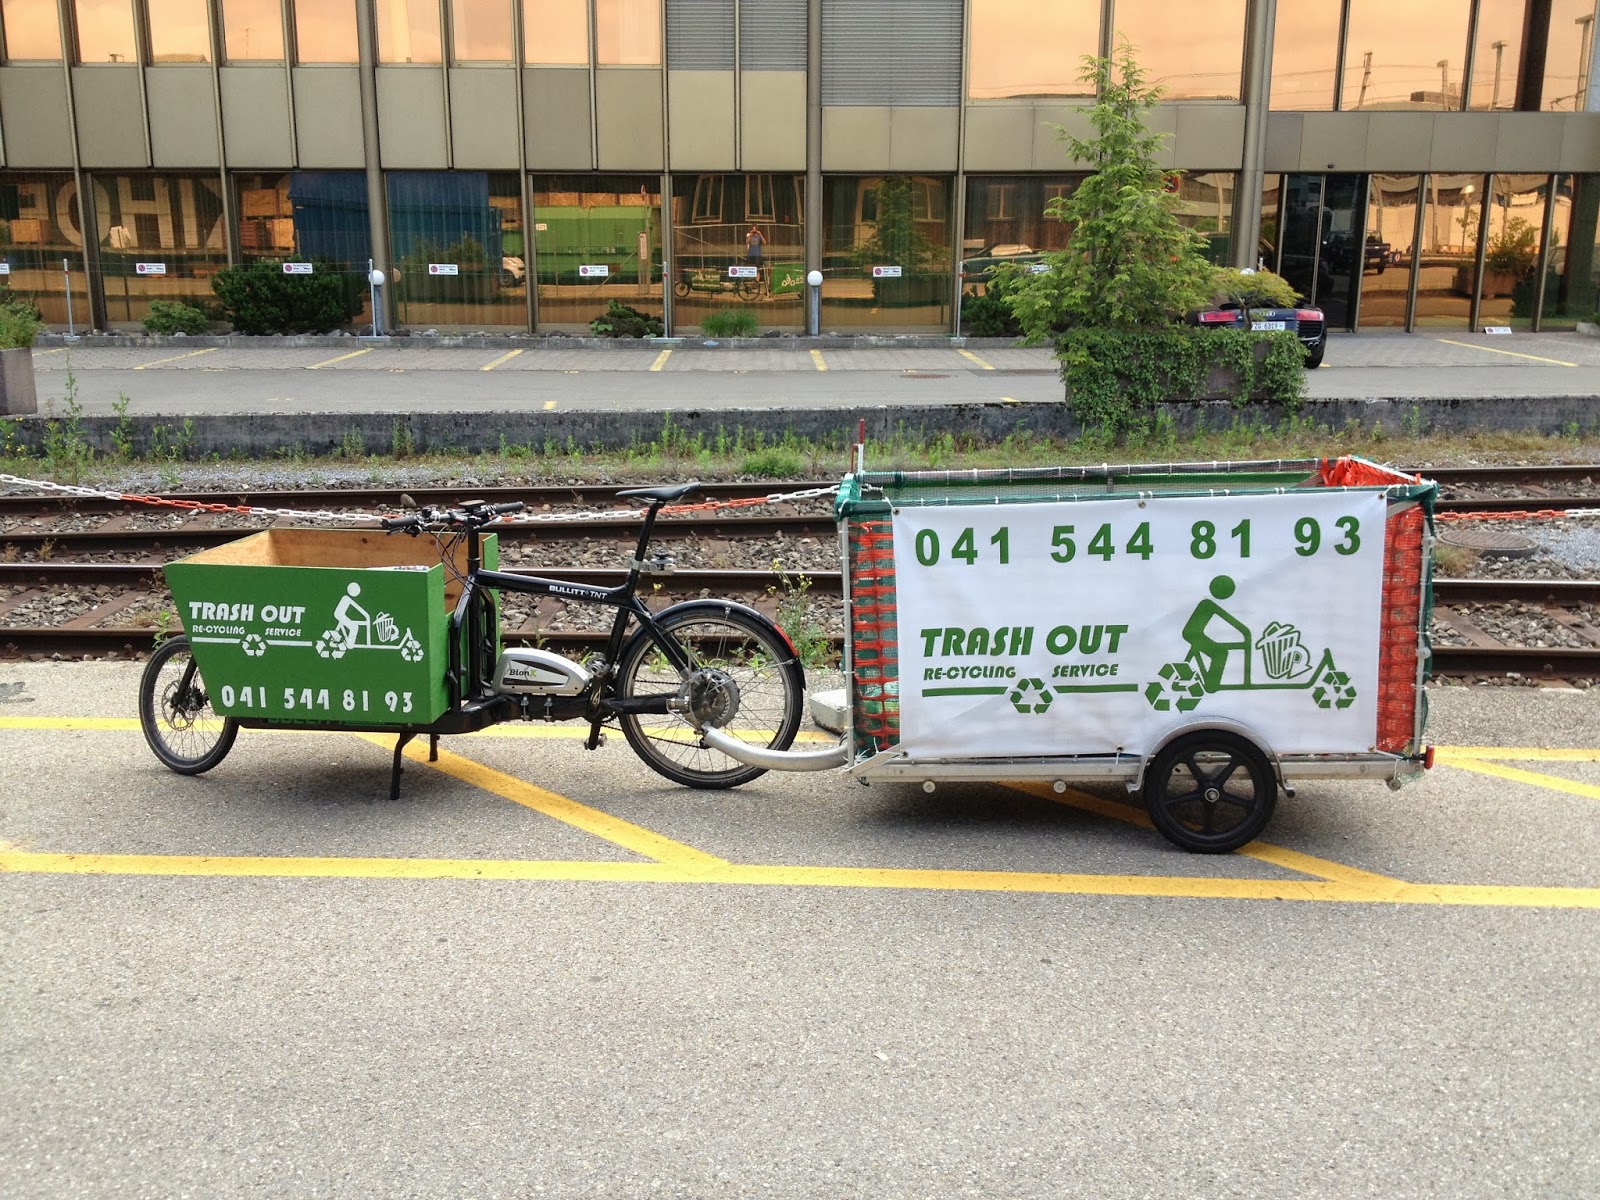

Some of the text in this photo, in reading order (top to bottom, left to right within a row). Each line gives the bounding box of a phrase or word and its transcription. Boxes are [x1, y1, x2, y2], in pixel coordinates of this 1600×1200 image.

[914, 516, 1360, 567] 041 544 81 93
[549, 585, 608, 599] BULLITT TNT
[188, 601, 306, 624] TRASH OUT
[192, 624, 302, 637] RE-CYCLING SERVICE
[920, 625, 1129, 657] TRASH OUT
[509, 668, 537, 677] BionX
[923, 663, 1119, 681] RE-CYCLING SERVICE
[221, 685, 413, 713] 041 544 81 93
